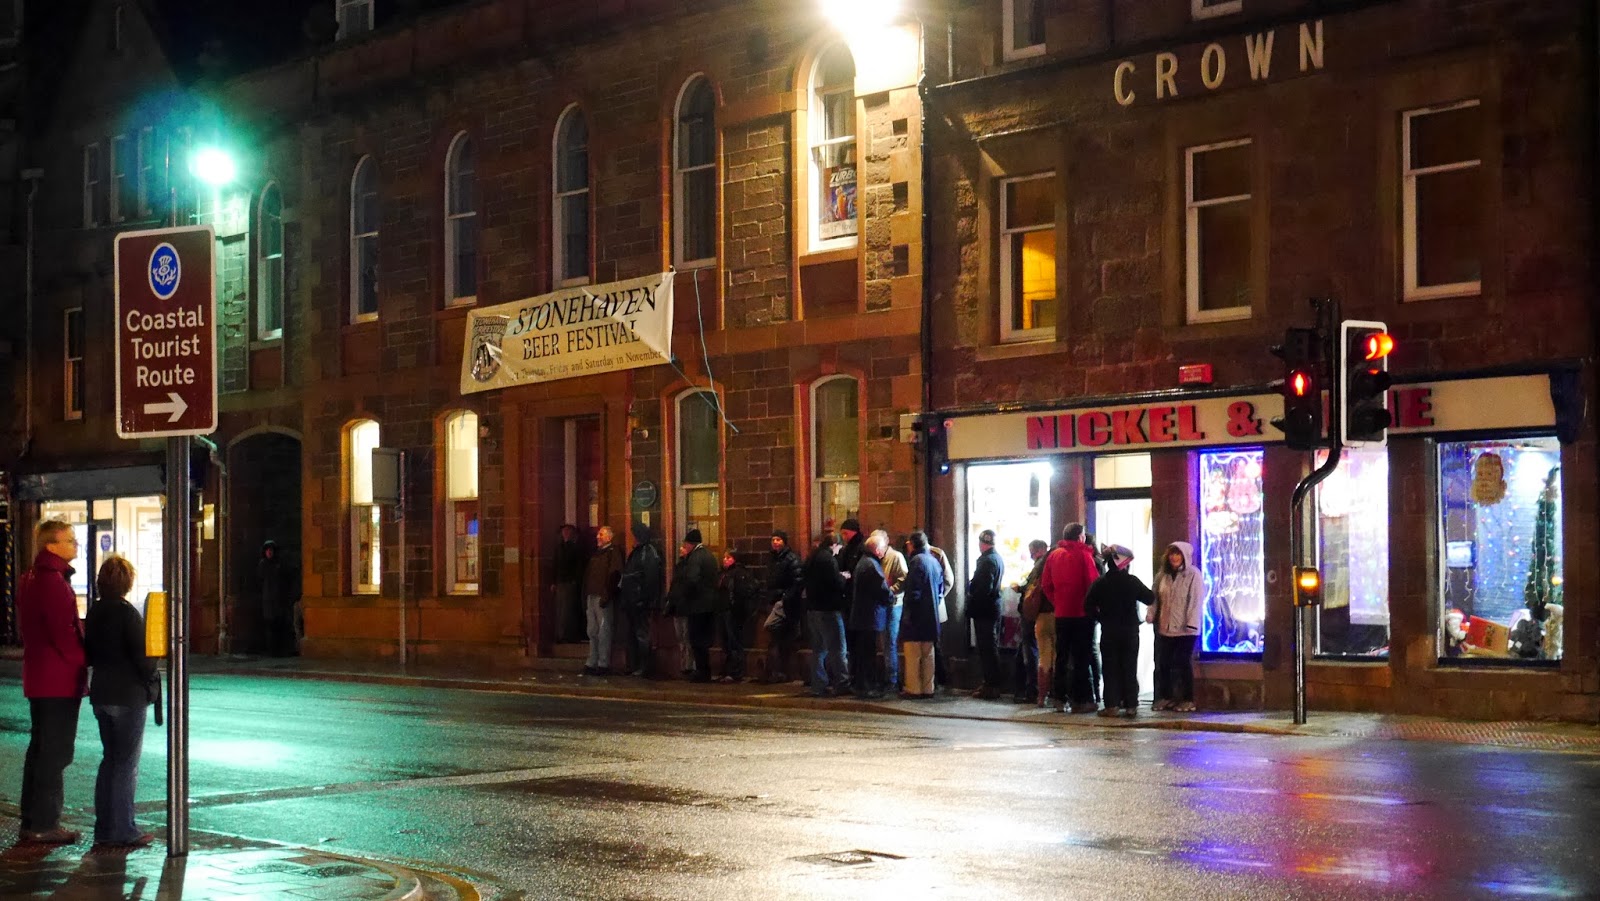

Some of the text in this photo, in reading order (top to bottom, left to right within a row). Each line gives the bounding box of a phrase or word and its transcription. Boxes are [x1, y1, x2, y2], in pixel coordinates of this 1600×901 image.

[1114, 19, 1324, 106] CROWN
[126, 305, 204, 332] Coastal
[513, 283, 661, 335] STONEHAVEN
[131, 334, 200, 360] Tourist
[522, 319, 641, 360] BEER FESTIVAL
[136, 363, 195, 388] Route
[571, 359, 583, 372] and
[585, 355, 613, 370] Saturday
[616, 356, 624, 365] in
[626, 347, 662, 363] November
[1026, 401, 1264, 450] NICKEL &
